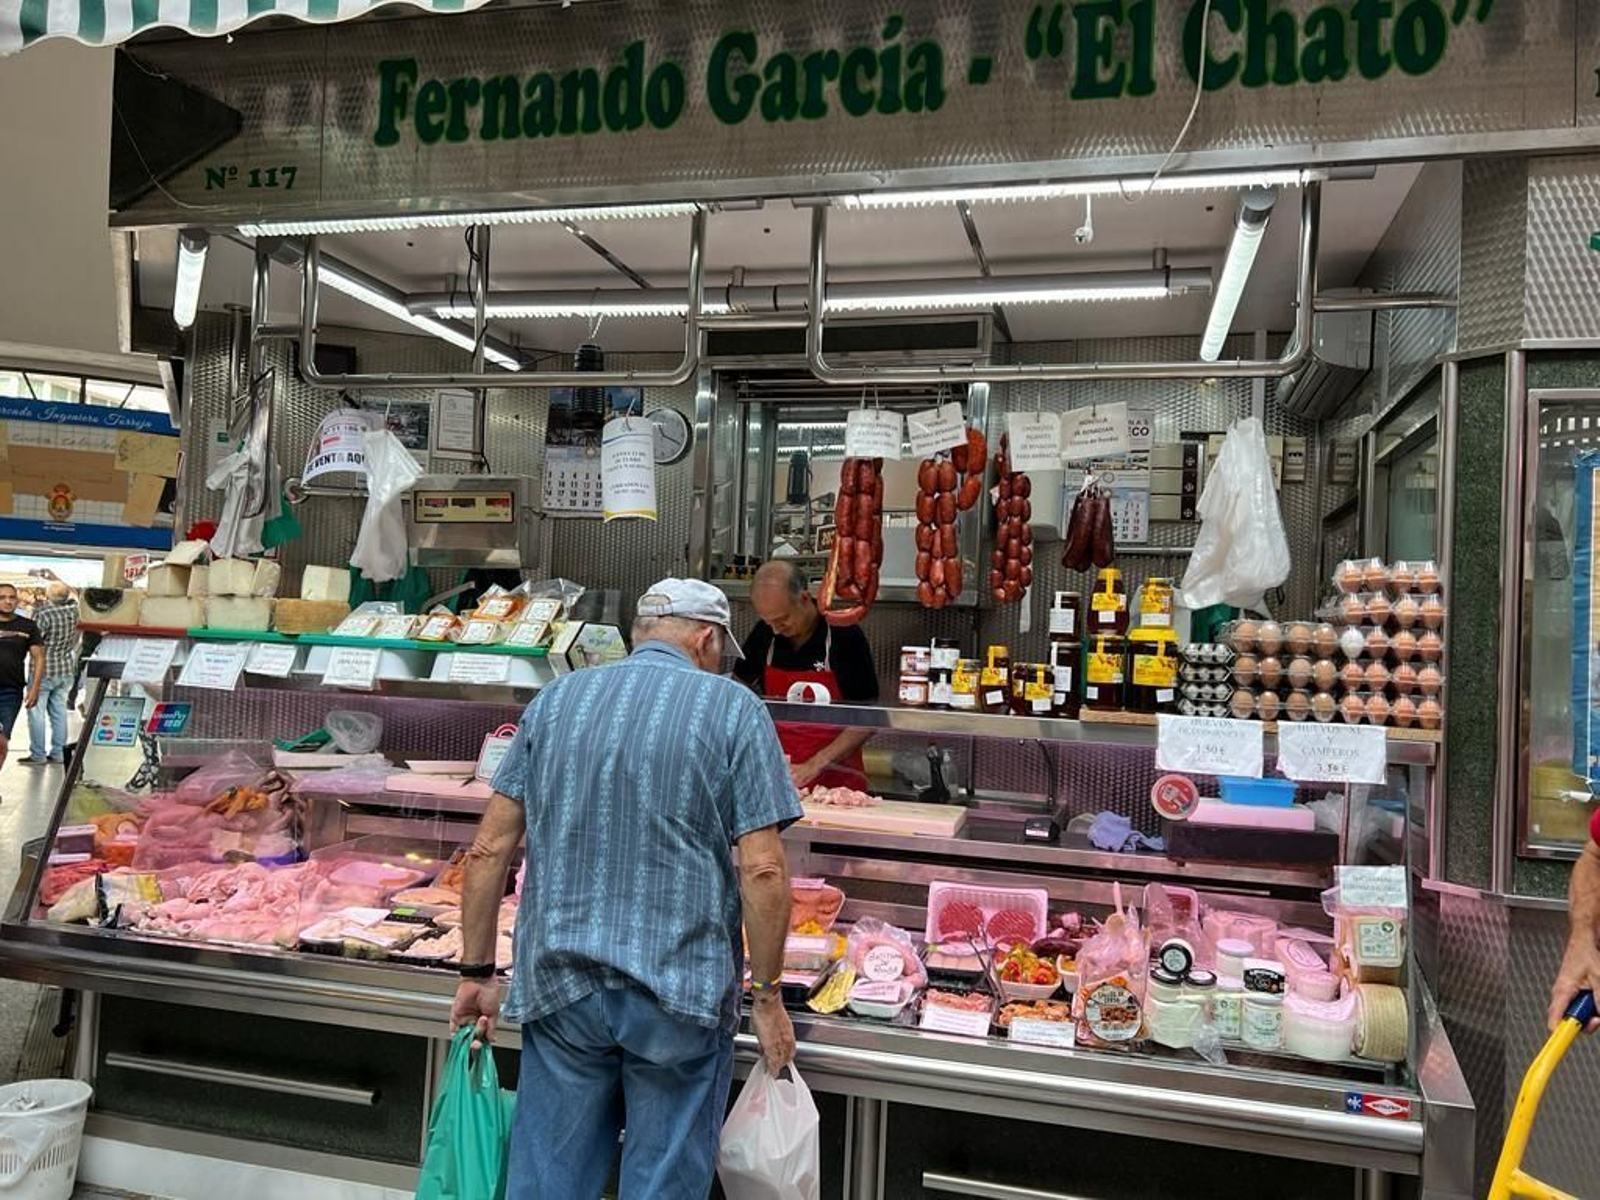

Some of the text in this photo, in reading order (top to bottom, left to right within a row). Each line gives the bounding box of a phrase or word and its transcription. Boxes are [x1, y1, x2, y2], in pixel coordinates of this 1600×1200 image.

[374, 40, 687, 147] Fernando
[706, 14, 947, 125] García
[248, 166, 298, 190] 117
[1190, 718, 1234, 728] HUEVOS
[1297, 724, 1340, 734] HUEVOS
[1301, 747, 1360, 757] CAMPEROS
